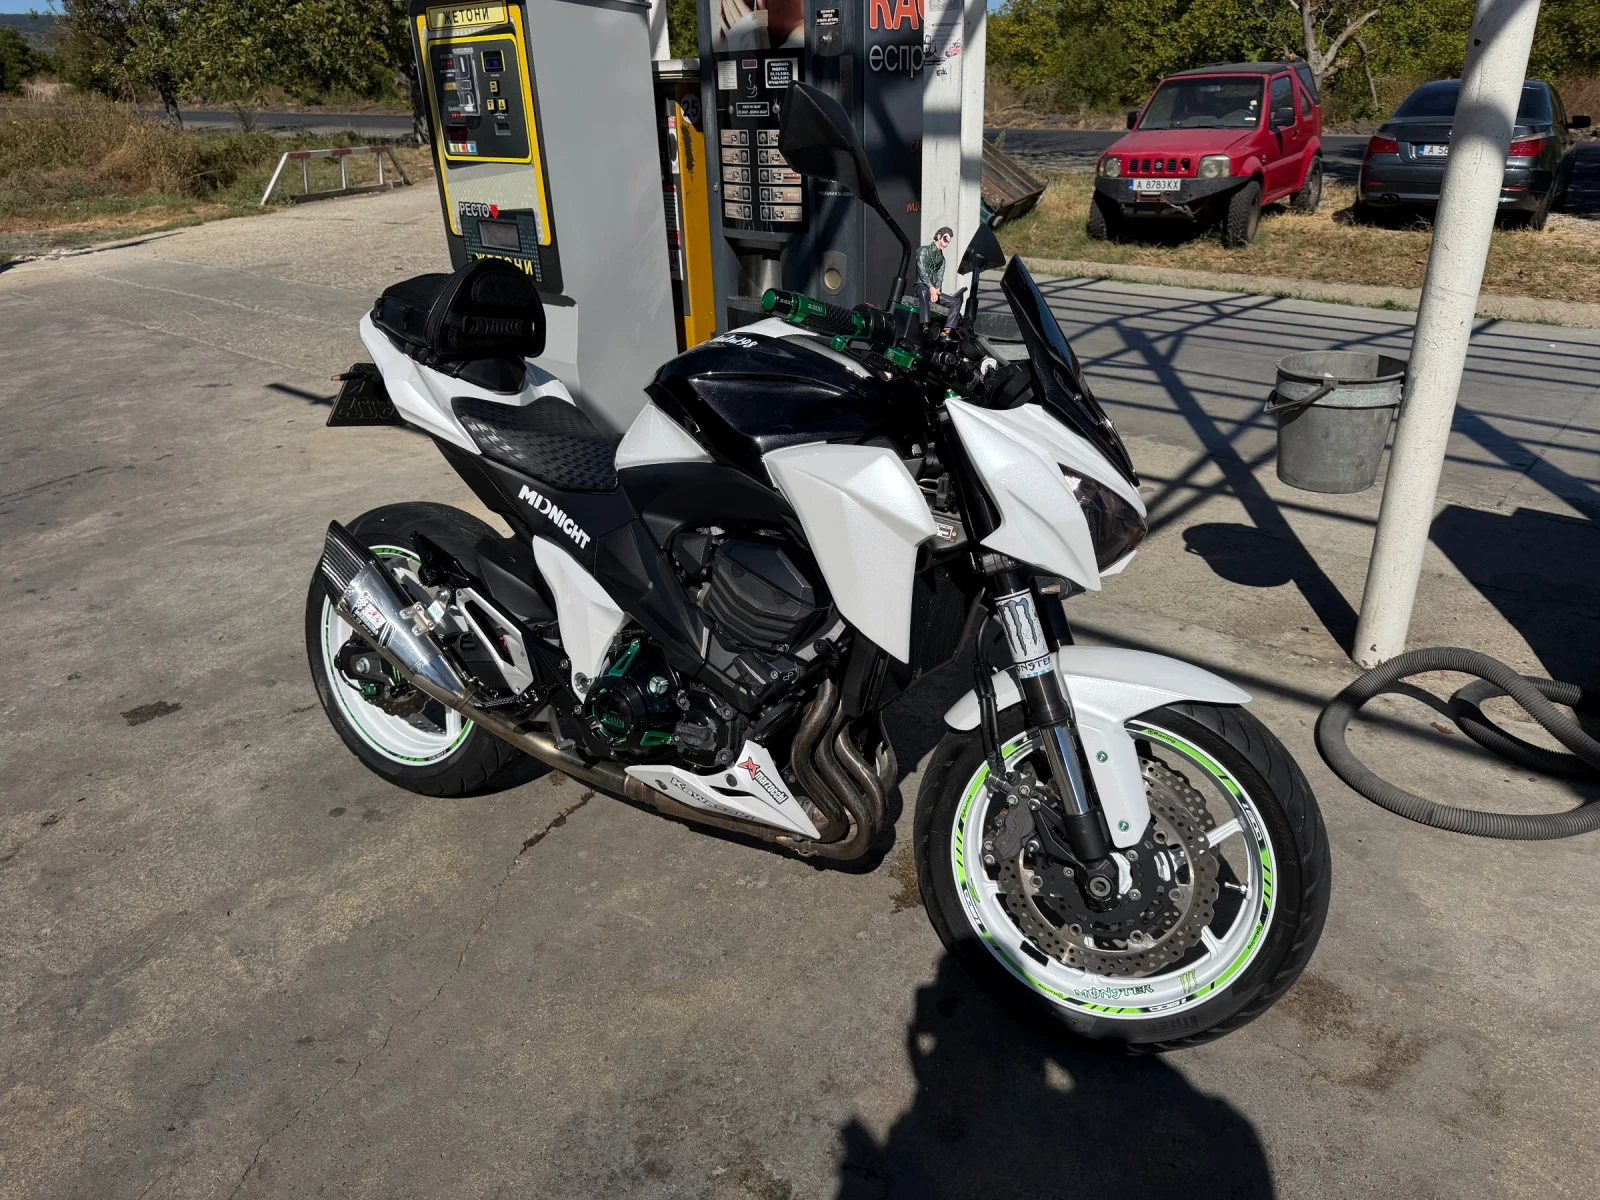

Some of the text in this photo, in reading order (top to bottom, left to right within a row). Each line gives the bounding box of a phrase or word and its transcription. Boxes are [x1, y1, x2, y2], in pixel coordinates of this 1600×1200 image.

[443, 7, 490, 25] ЖЕТОНИ
[682, 100, 699, 117] 25
[459, 202, 490, 218] РЕСТО
[518, 484, 590, 550] MIDNIGHT
[754, 769, 789, 805] marzocchi
[1073, 983, 1155, 1000] MONSTER
